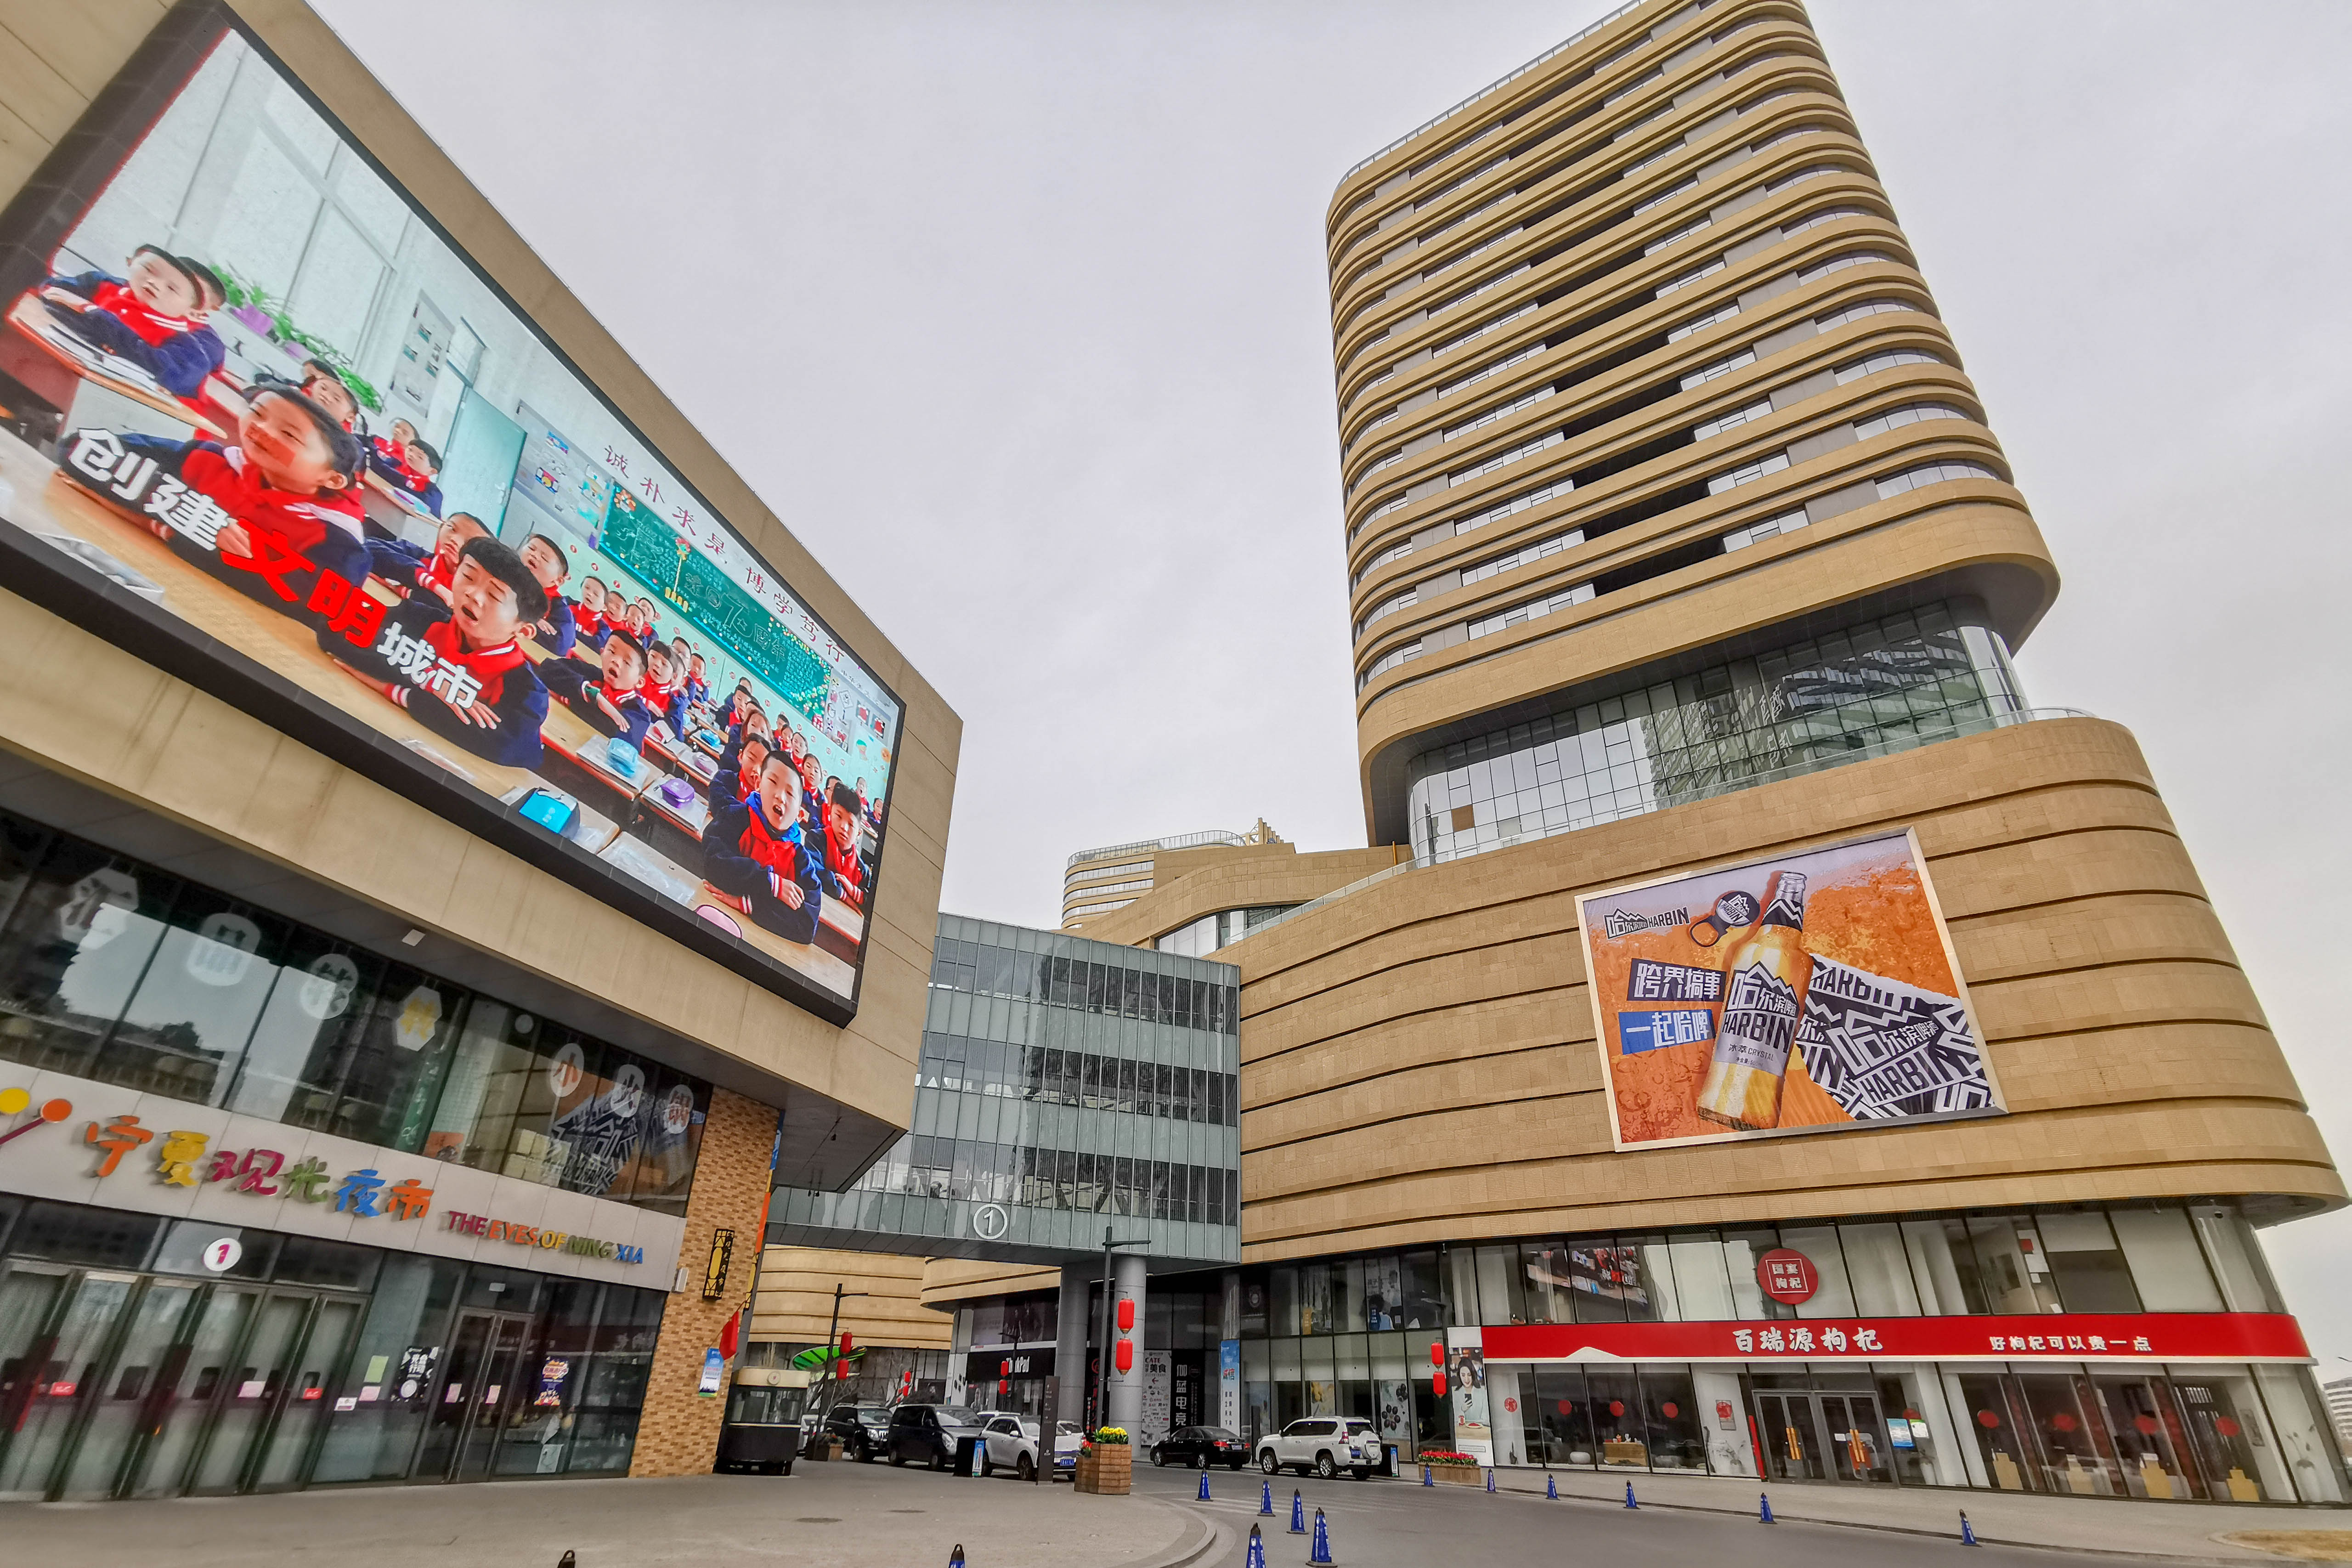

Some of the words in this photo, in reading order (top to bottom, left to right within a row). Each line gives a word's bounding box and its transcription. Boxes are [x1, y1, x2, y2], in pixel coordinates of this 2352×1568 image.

[68, 428, 482, 710] 创建文明城市
[1648, 906, 1690, 928] HARBIN
[1634, 963, 1721, 999] 跨界搞事
[1727, 963, 1798, 1016] 哈尔滨啤酒
[1626, 1010, 1709, 1047] 一起哈啤
[1722, 1012, 1794, 1053] HARBIN
[1826, 1009, 1939, 1076] 哈尔滨啤酒
[1728, 1043, 1747, 1053] 冰萃
[1748, 1047, 1774, 1061] CRYSTAL
[1860, 1043, 1974, 1104] HARBIN
[85, 1115, 435, 1221] 宁夏观光夜市
[449, 1211, 488, 1235] THE
[488, 1219, 539, 1245] EYES
[539, 1231, 568, 1249] OF
[567, 1235, 614, 1258] NING
[615, 1243, 643, 1264] XIA
[1775, 1277, 1802, 1289] 枸杞
[1732, 1327, 1883, 1352] 百瑞源枸杞
[1989, 1336, 2152, 1351] 好枸杞可以贵一点
[1150, 1364, 1166, 1373] 美食
